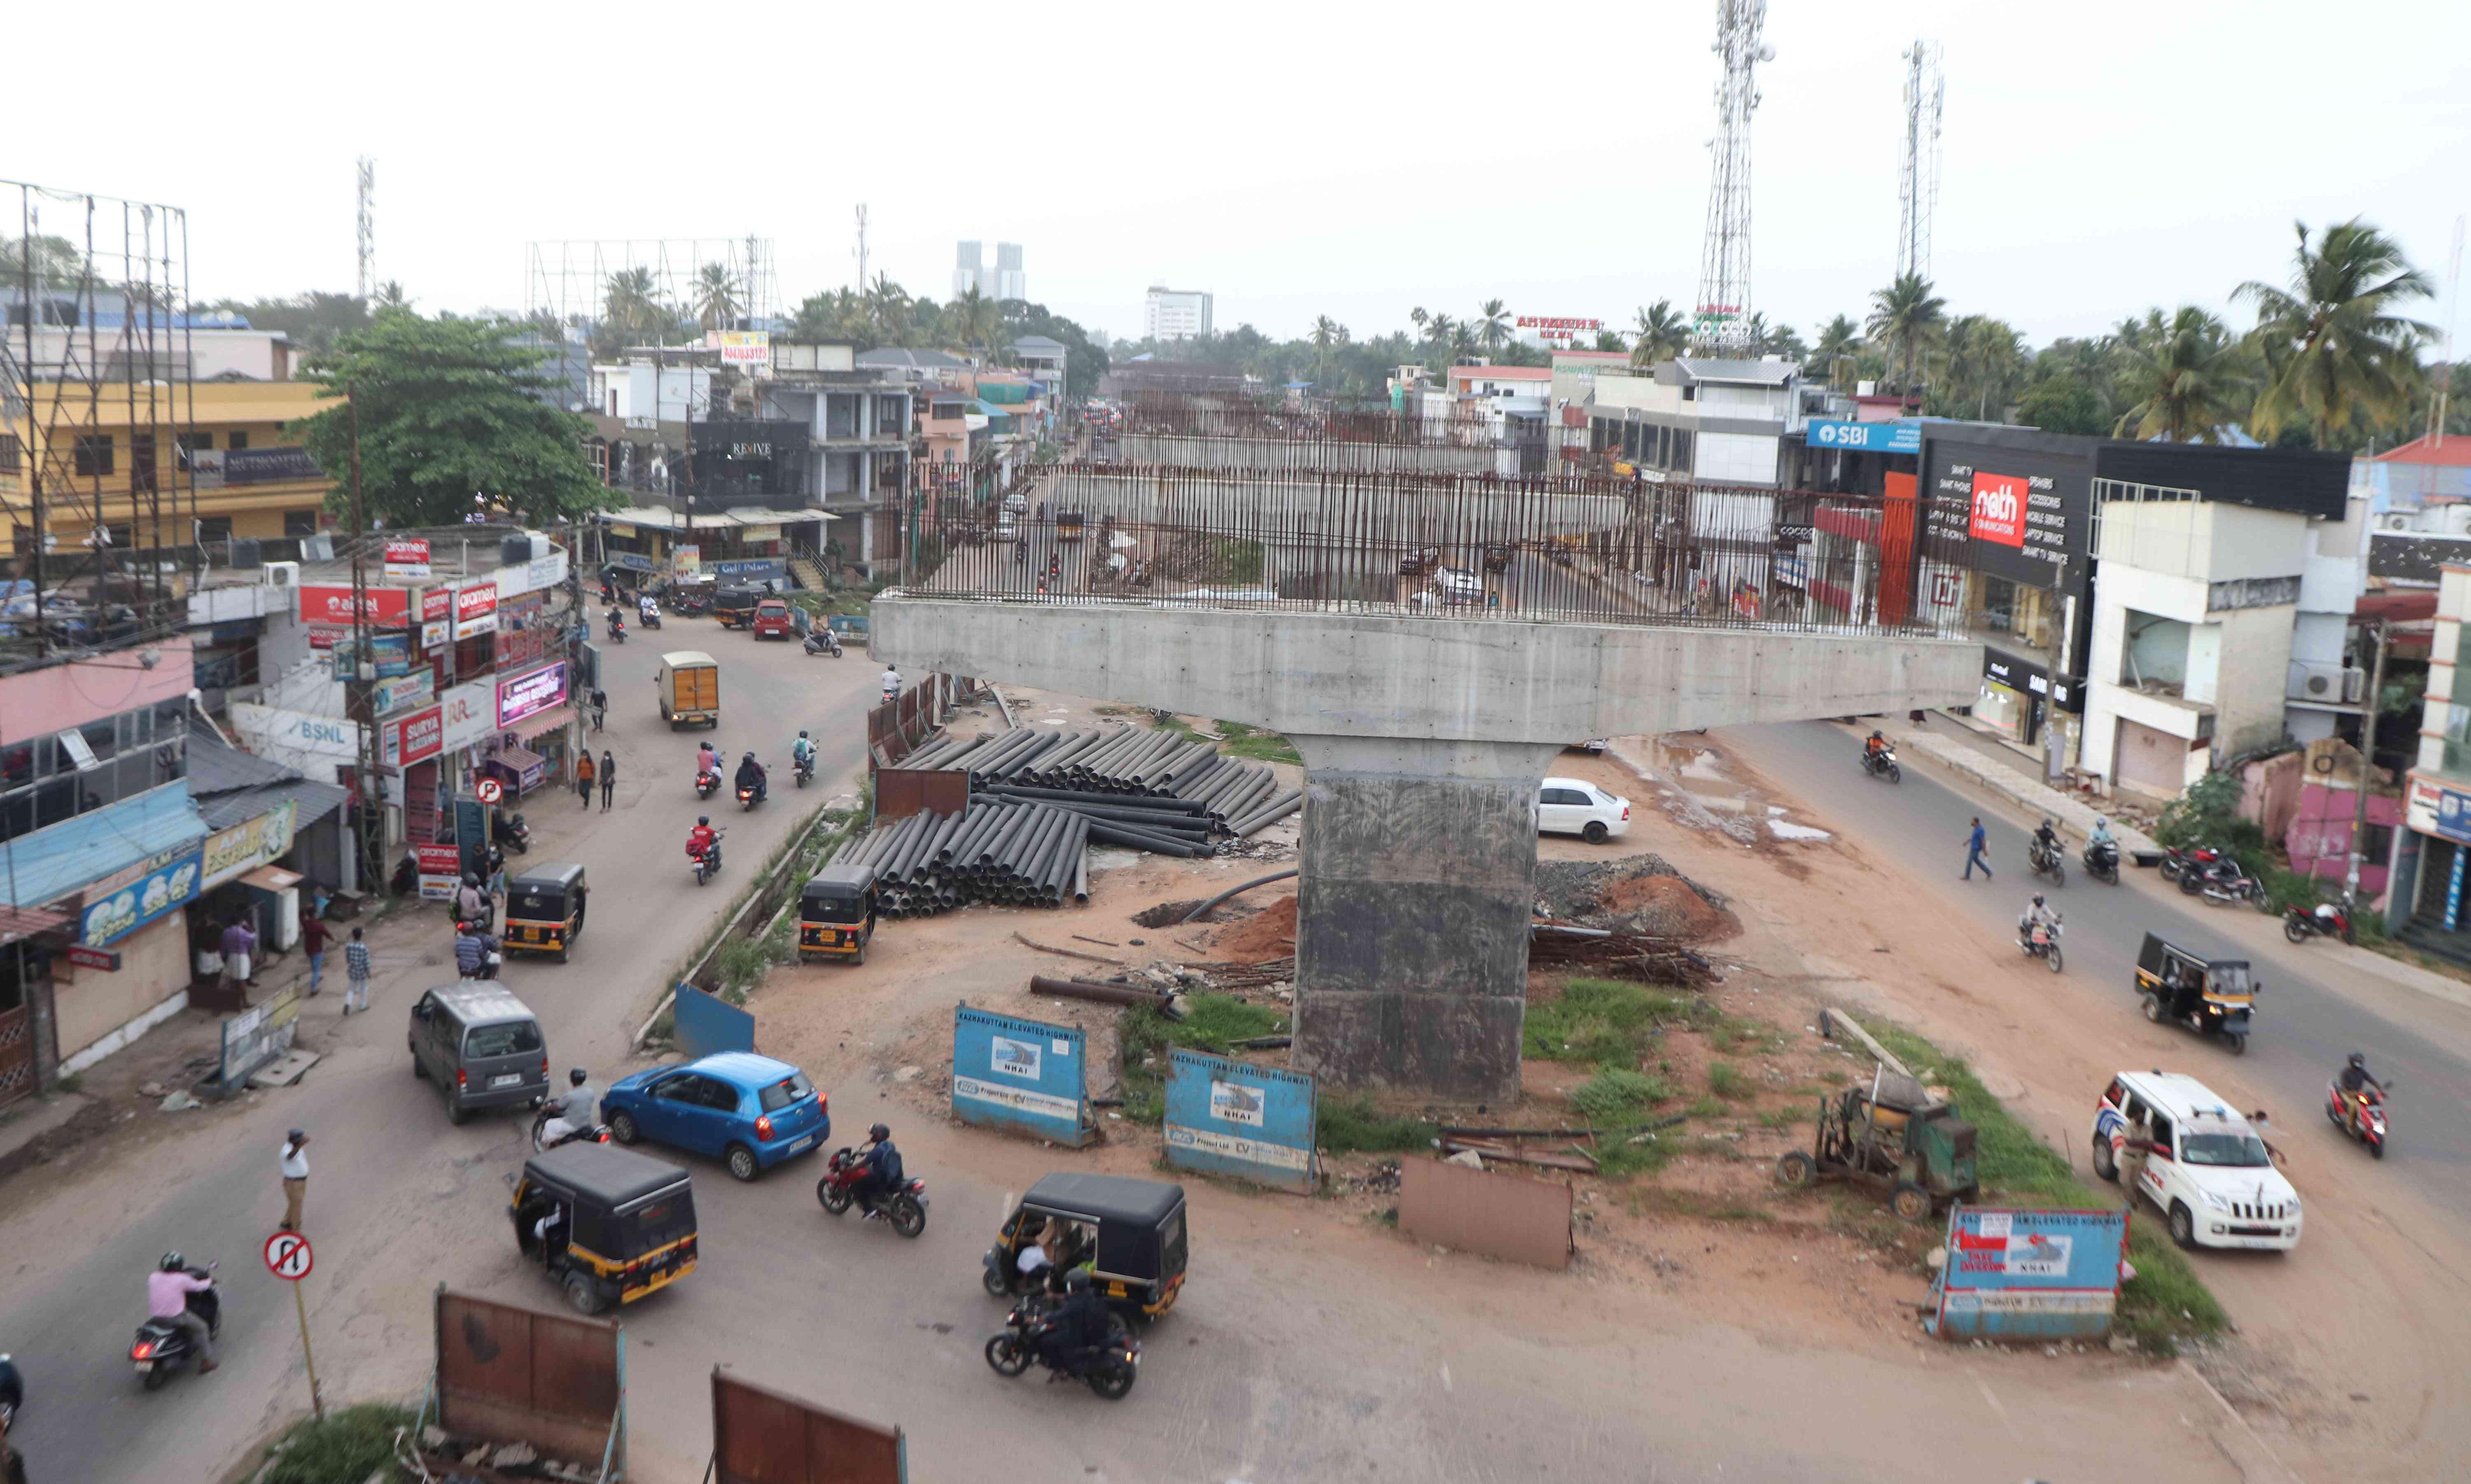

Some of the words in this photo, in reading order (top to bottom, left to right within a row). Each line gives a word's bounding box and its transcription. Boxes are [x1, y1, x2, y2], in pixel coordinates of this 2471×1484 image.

[1838, 425, 1868, 446] SBI
[424, 593, 450, 609] aramex
[459, 586, 496, 608] aramex
[2029, 674, 2067, 702] SAMNG
[303, 721, 346, 744] BSNL
[406, 716, 439, 740] SURYA
[419, 847, 458, 858] aramex
[958, 1012, 1008, 1029] KAZHAKUTTAM
[1009, 1022, 1044, 1036] ELEVATED
[1046, 1029, 1079, 1043] HIGHWAY
[1004, 1064, 1028, 1075] NHAI
[1171, 1054, 1227, 1071] KAZHAKUTTAM
[1230, 1064, 1270, 1079] ELEVATED
[1272, 1072, 1310, 1086] HIGHWAY
[1224, 1109, 1251, 1120] NHAI
[1197, 1137, 1218, 1148] Project
[2020, 1263, 2051, 1273] NHAI
